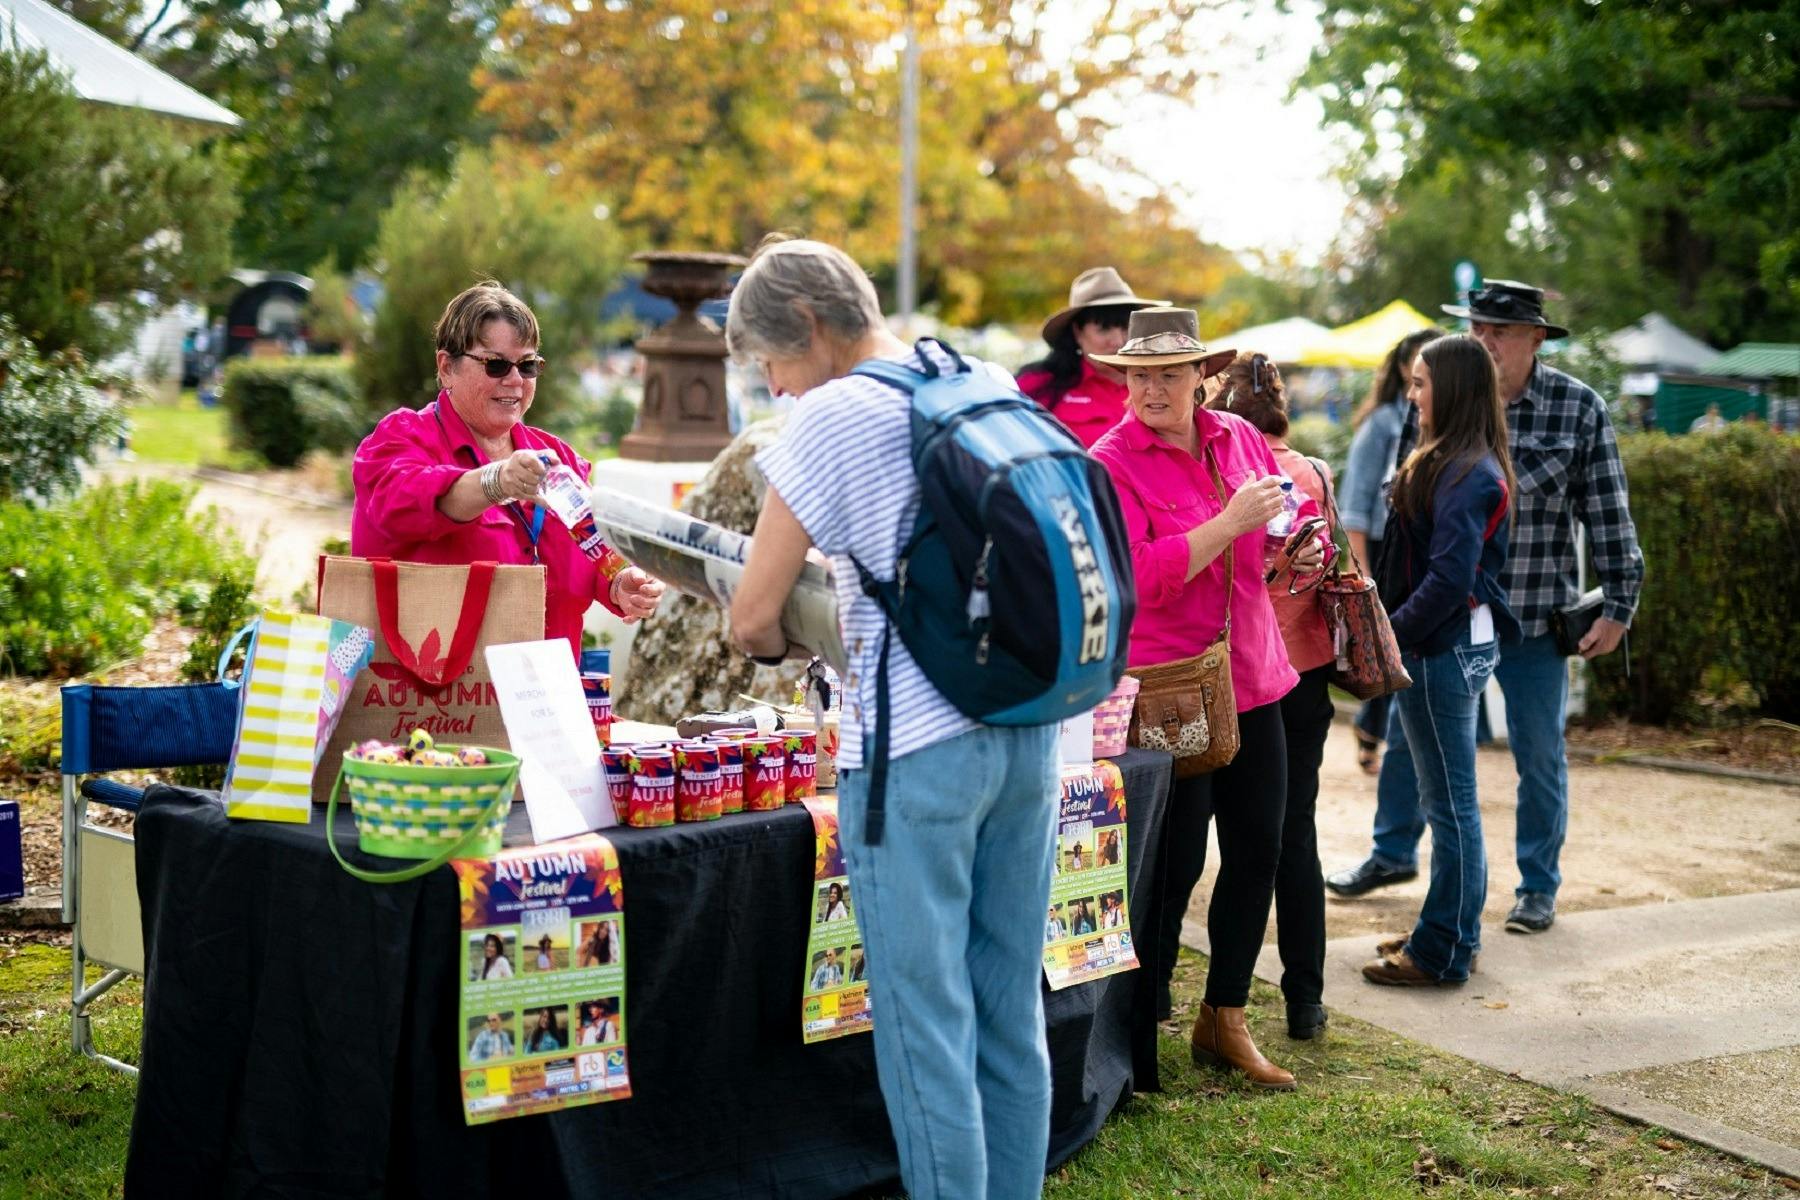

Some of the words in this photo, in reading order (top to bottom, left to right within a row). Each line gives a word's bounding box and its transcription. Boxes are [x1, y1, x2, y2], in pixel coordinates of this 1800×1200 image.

[1051, 495, 1109, 665] NIKE
[391, 711, 477, 739] Festival
[495, 852, 587, 882] AUTUMN
[519, 879, 567, 900] Festival
